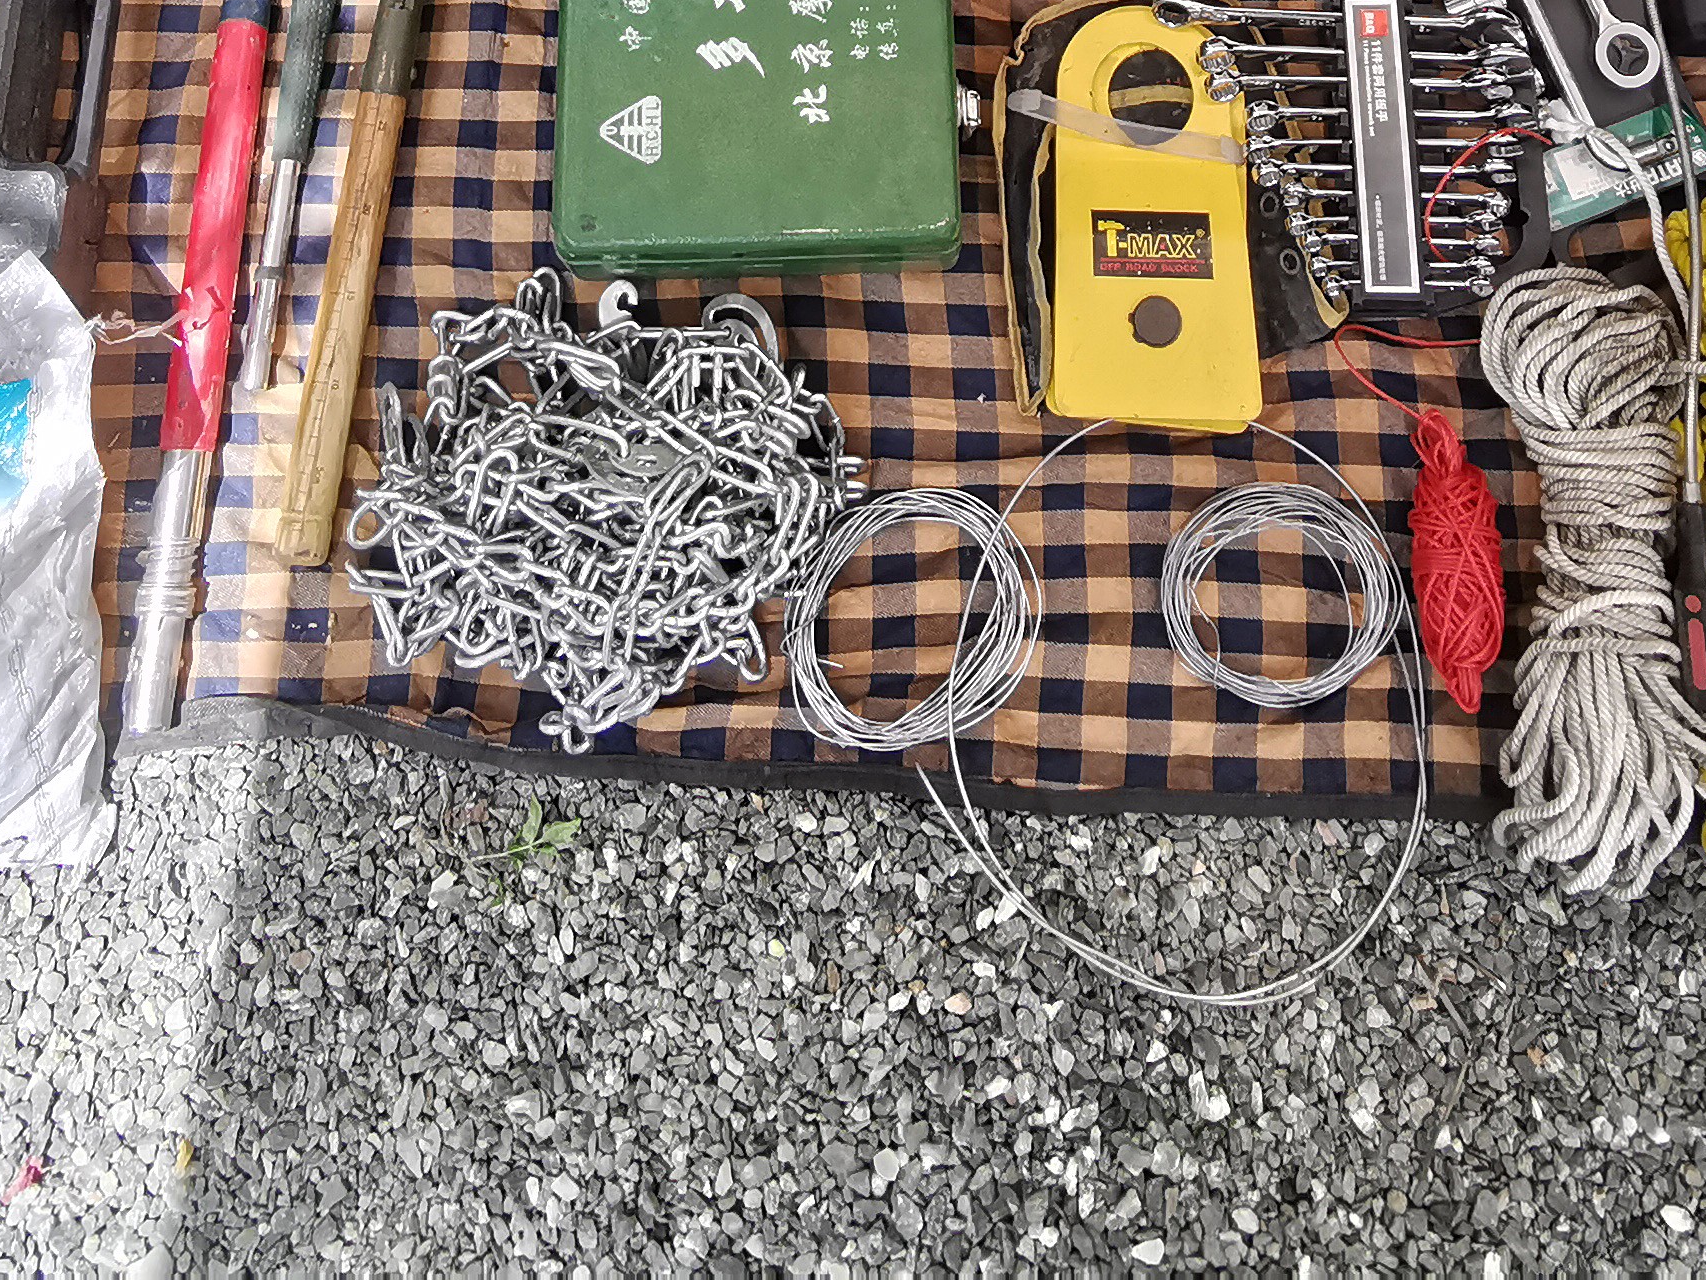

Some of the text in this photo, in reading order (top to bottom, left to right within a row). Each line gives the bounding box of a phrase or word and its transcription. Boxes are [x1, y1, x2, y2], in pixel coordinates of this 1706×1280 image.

[1097, 219, 1197, 259] T-MAX
[1125, 263, 1158, 273] ROAD
[1160, 263, 1200, 273] BLOCK
